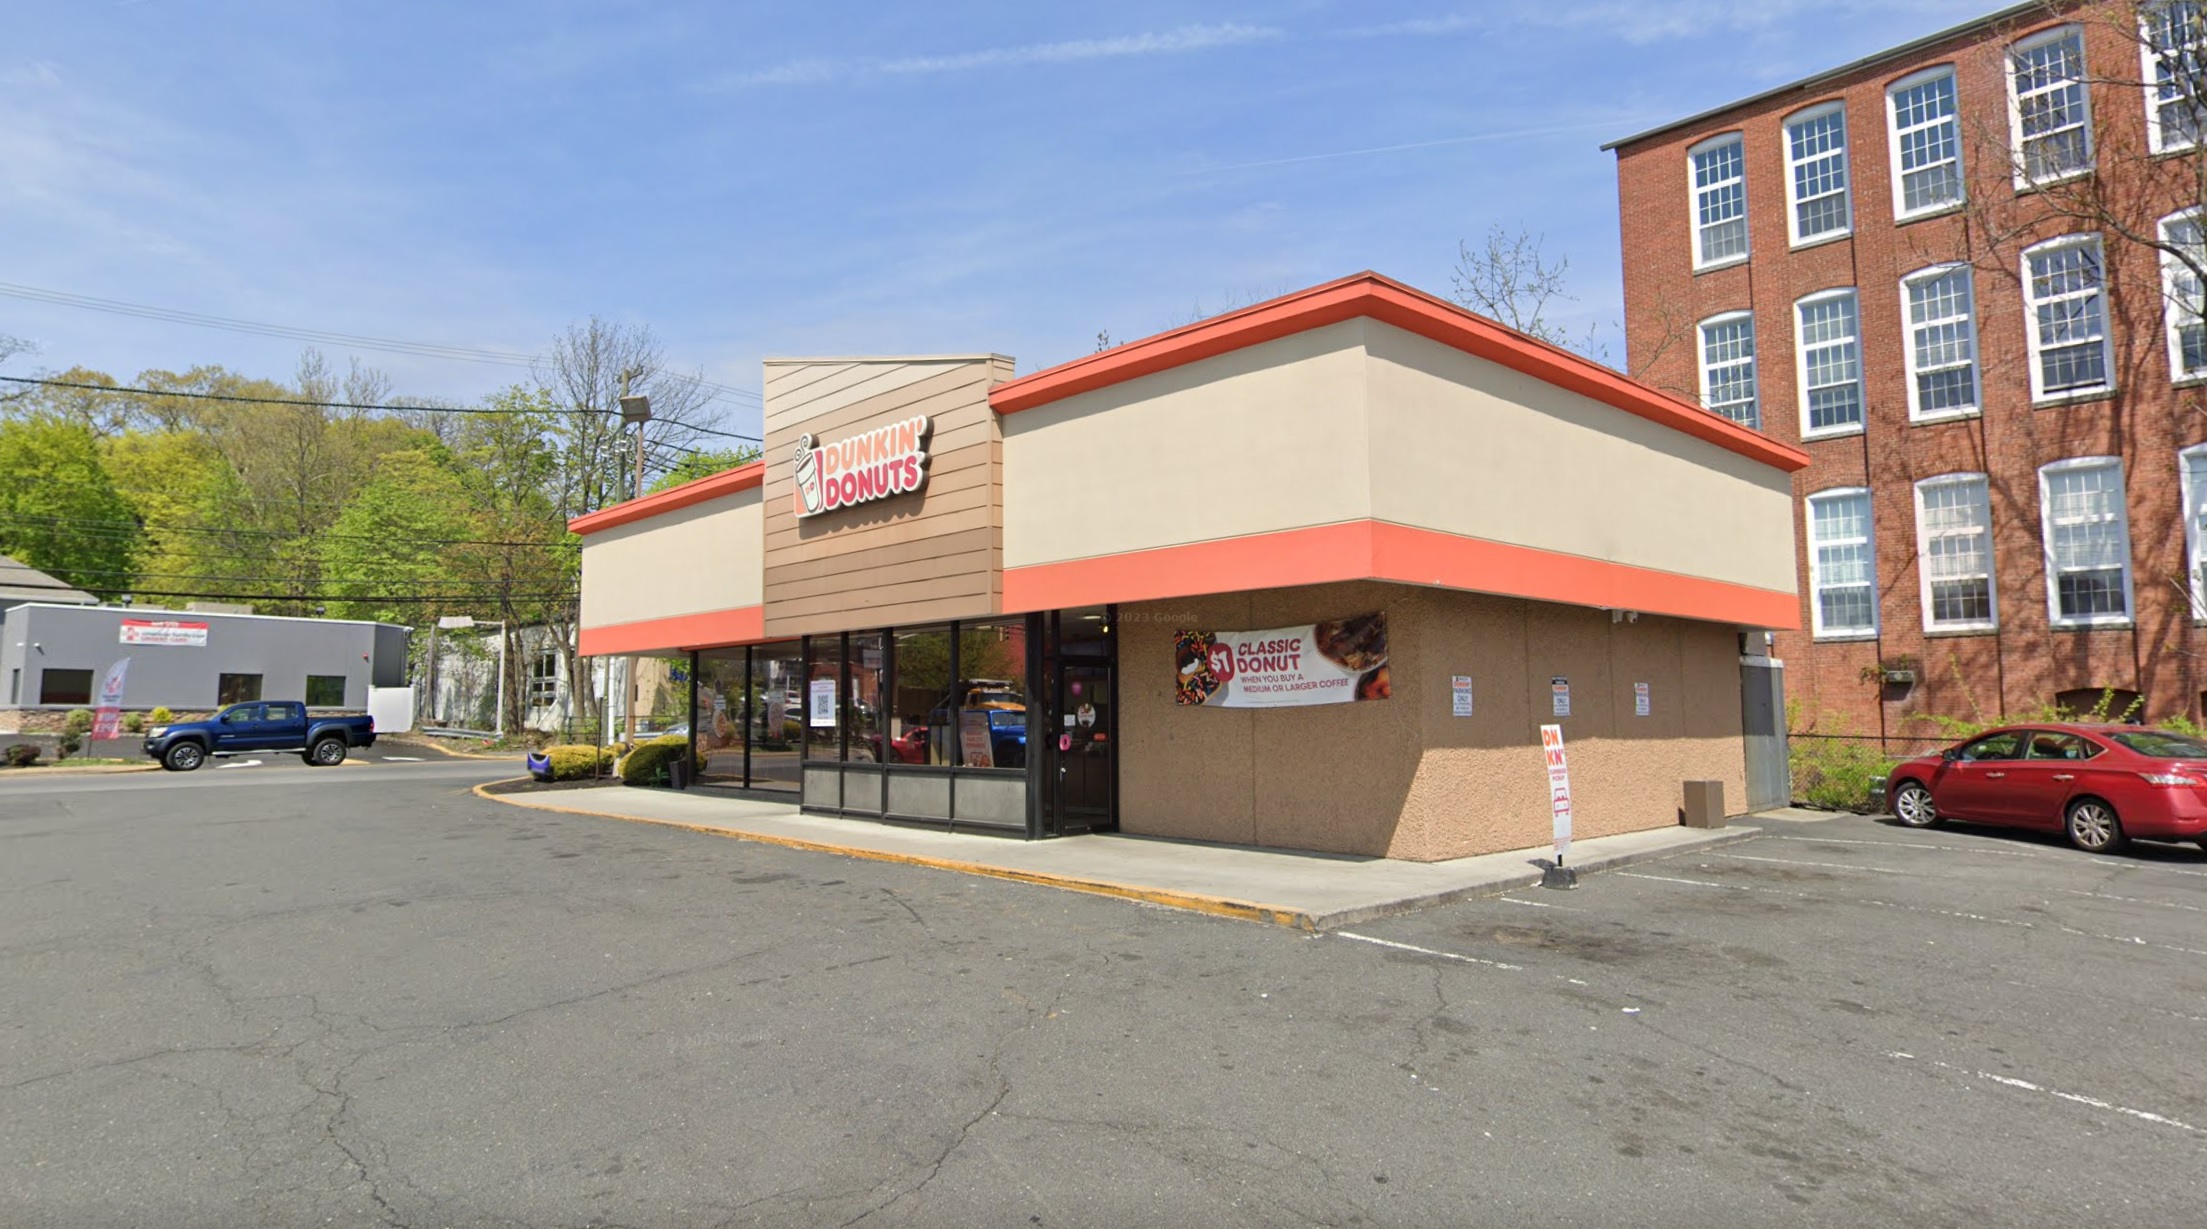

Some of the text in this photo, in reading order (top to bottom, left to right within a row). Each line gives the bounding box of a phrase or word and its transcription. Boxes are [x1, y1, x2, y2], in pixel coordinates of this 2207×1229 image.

[826, 418, 923, 475] DUNKIN'
[826, 454, 918, 507] DONUTS
[1238, 638, 1301, 656] CLASSIC
[1211, 650, 1230, 673] $1
[1237, 654, 1301, 673] DONUT
[1241, 673, 1304, 683] WHEN YOU BUY A
[1243, 678, 1349, 693] MEDIUM OR LARGER COFFEE
[1543, 729, 1559, 746] DN
